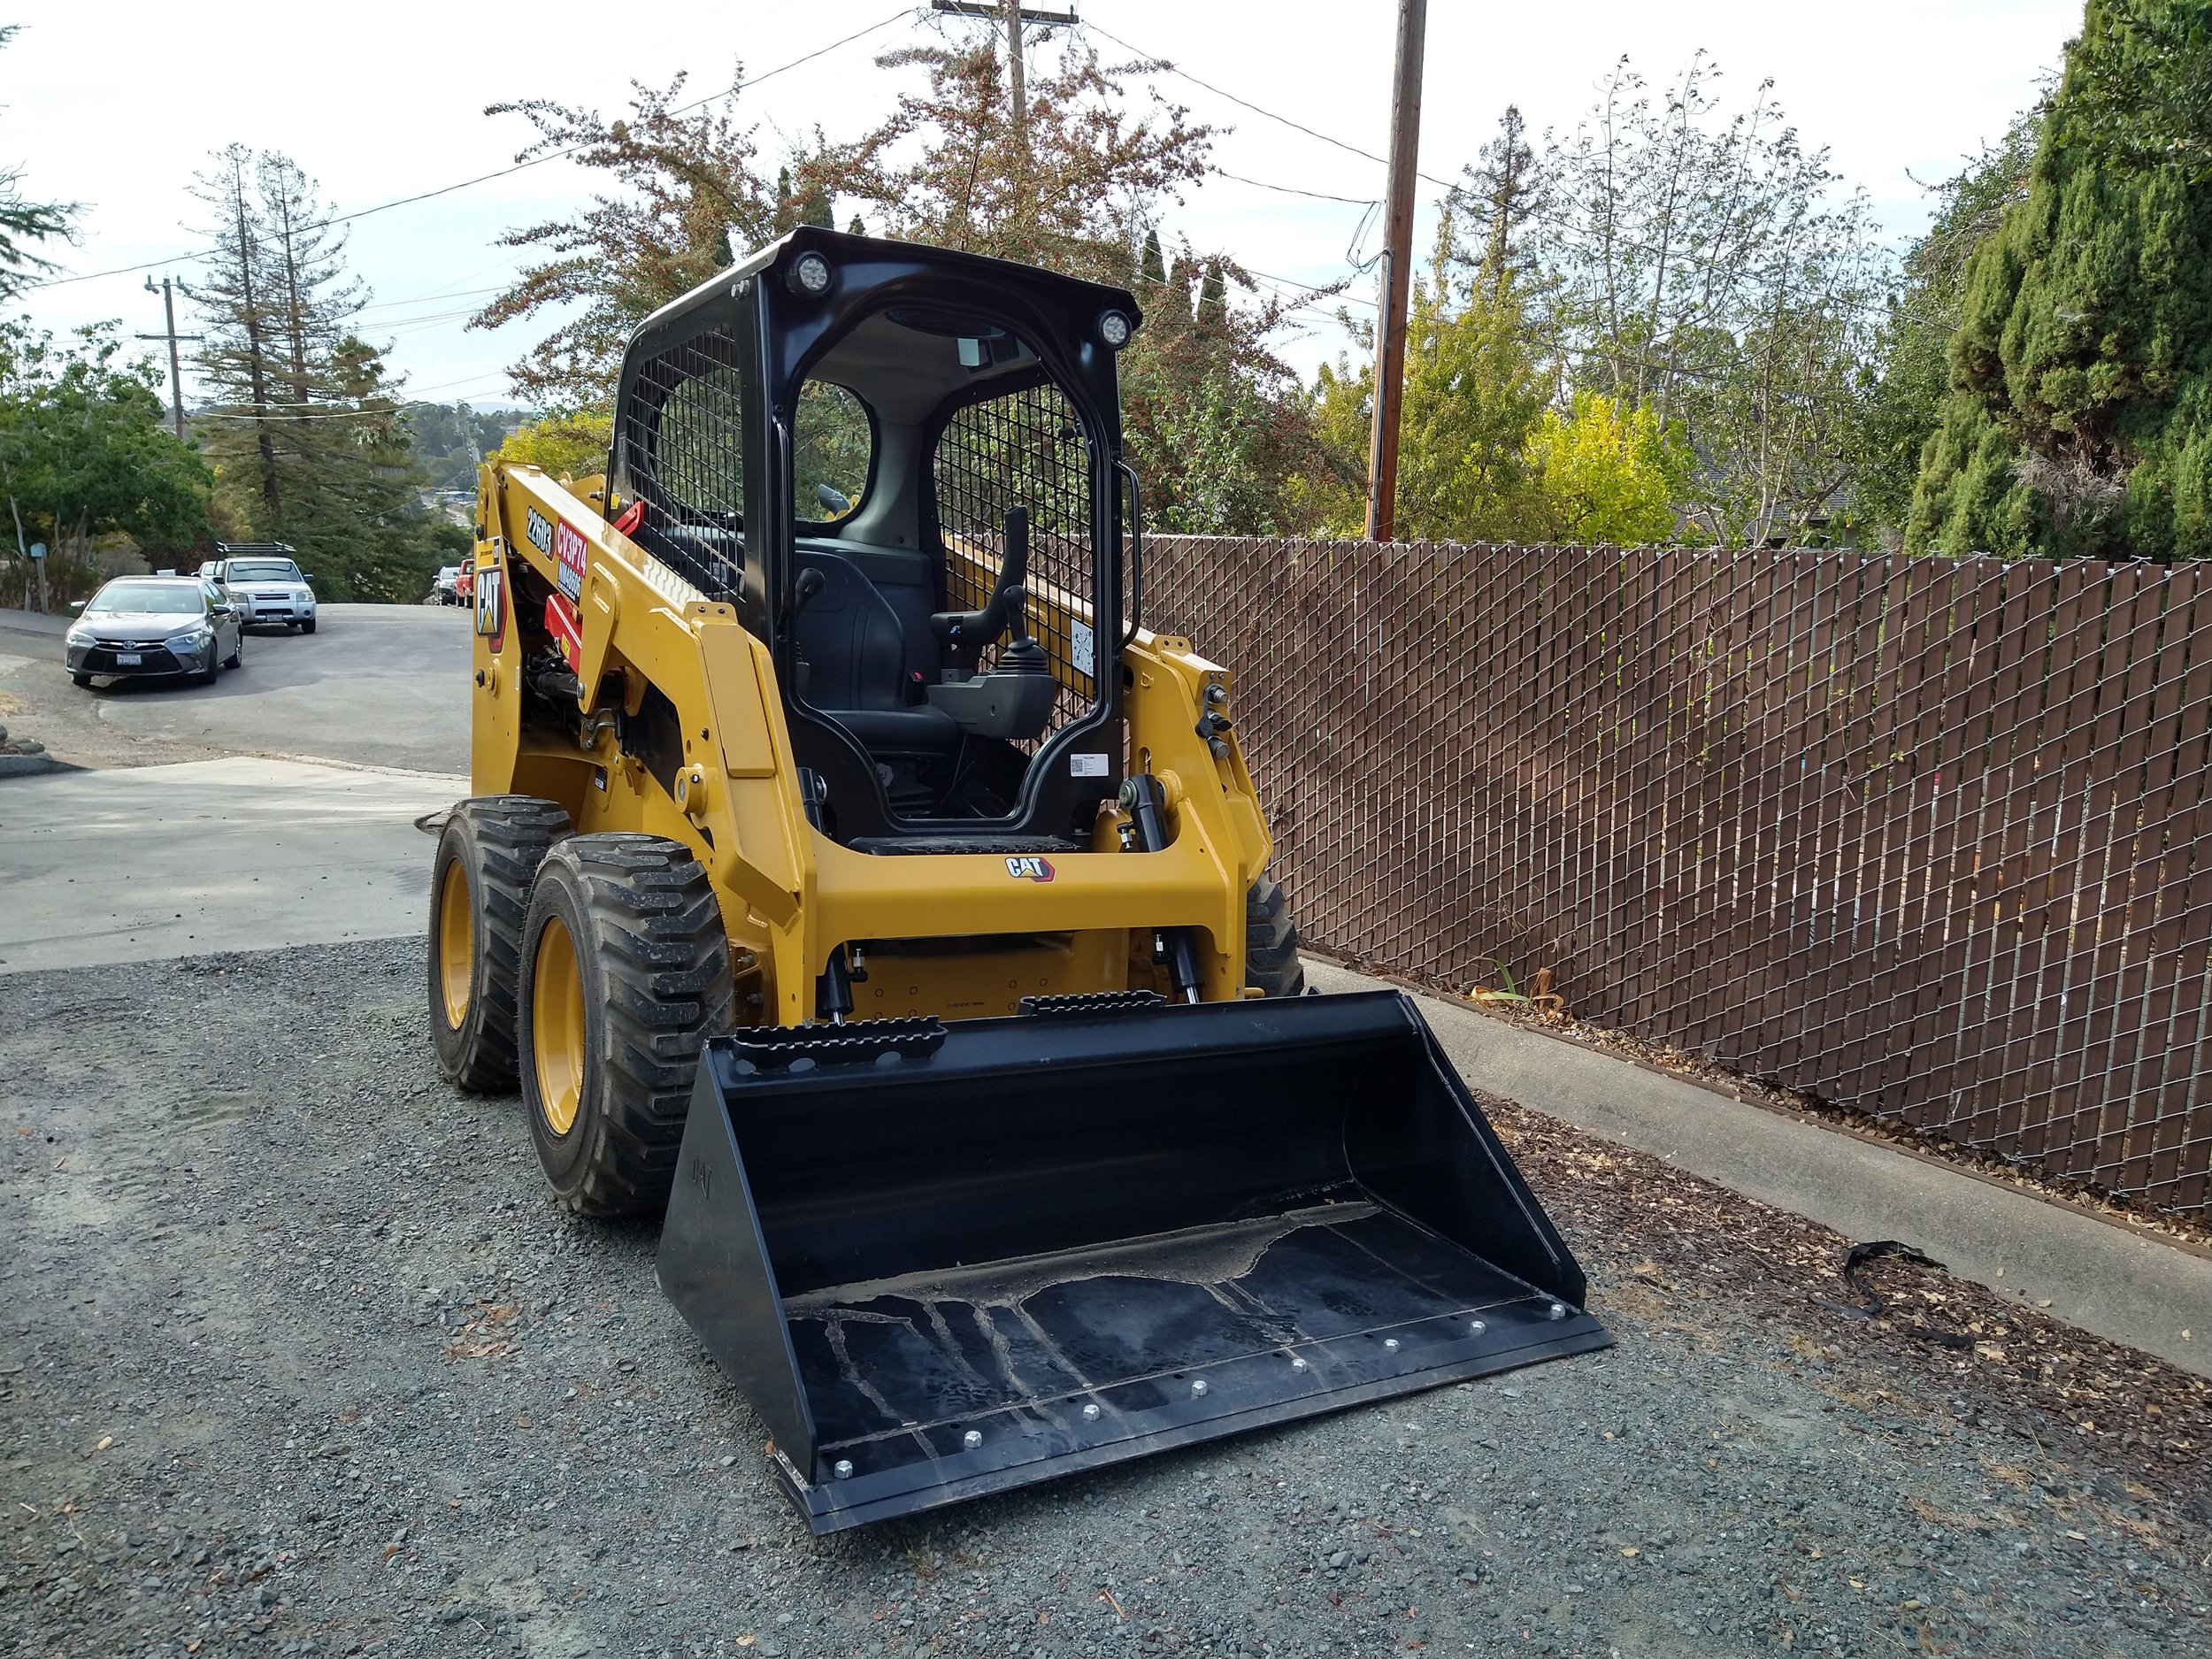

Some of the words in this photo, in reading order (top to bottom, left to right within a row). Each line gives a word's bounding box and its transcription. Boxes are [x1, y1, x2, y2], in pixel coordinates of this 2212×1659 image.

[526, 506, 552, 557] 226D3
[557, 522, 587, 576] CV3P74
[477, 572, 500, 634] CAT
[1005, 857, 1043, 878] CAT
